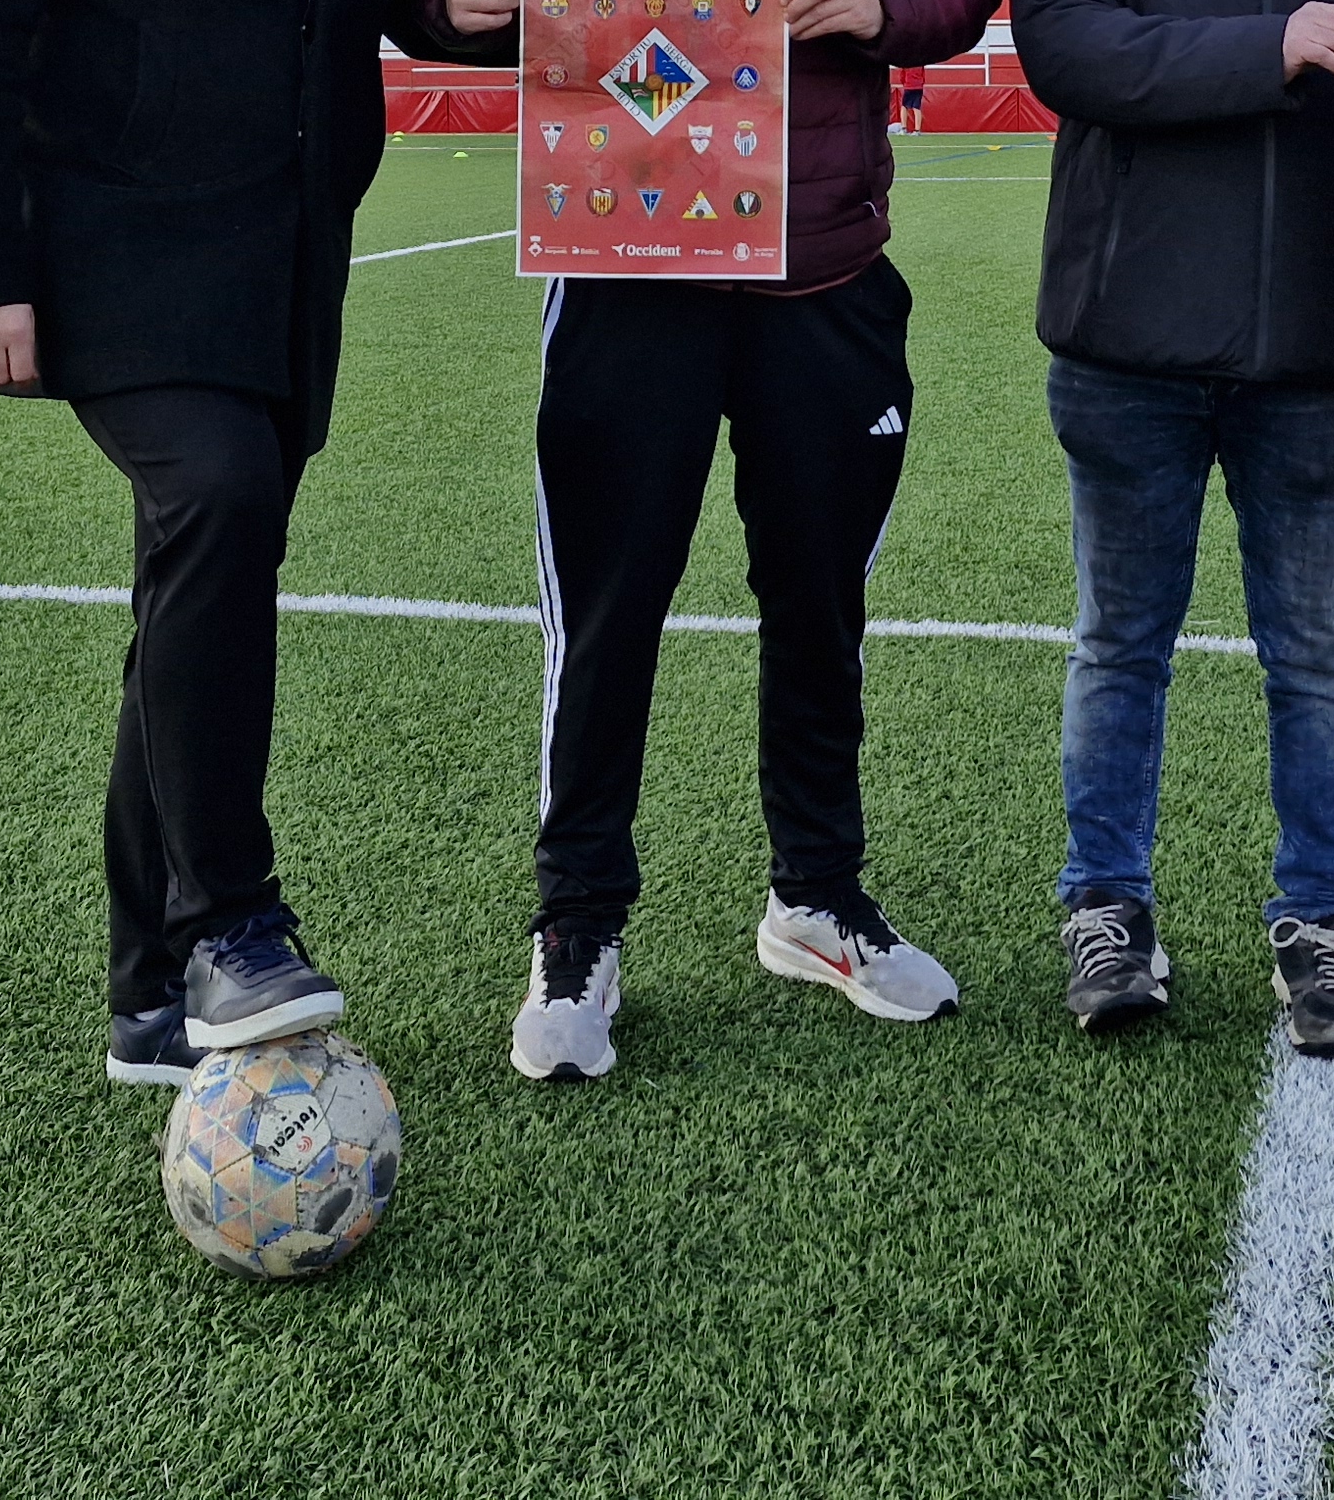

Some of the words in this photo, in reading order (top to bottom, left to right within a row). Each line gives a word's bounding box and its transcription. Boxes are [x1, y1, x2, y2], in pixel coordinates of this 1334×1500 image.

[609, 38, 651, 80] ESPORTIU
[663, 43, 693, 75] BERGA
[616, 91, 641, 117] CLUB
[626, 244, 681, 257] Occident
